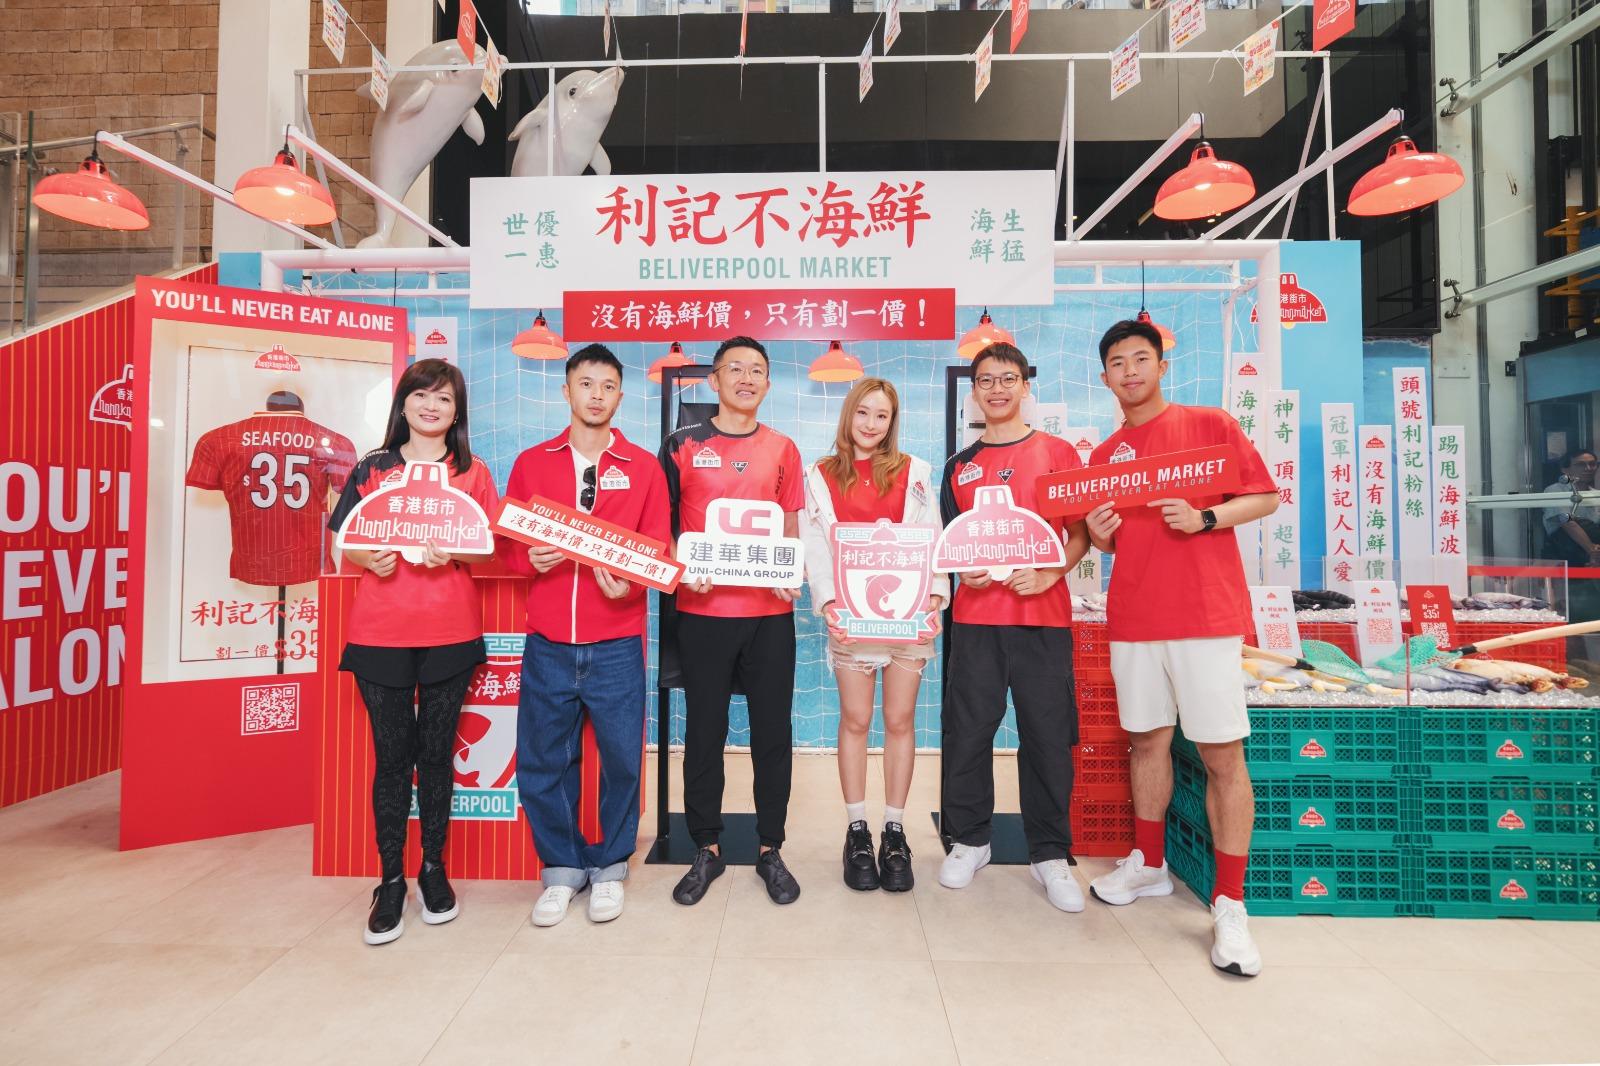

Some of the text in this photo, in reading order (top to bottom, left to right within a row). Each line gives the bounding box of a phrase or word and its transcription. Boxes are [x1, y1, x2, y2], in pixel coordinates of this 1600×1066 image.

[595, 180, 931, 248] 利記不海鮮
[639, 256, 892, 279] BELIVERPOOL MARKET
[151, 288, 394, 332] YOU'LL NEVER EAT ALONE
[241, 431, 315, 449] SEAFOOD
[1274, 398, 1295, 445] 神奇
[1400, 376, 1425, 517] 頭號利記粉絲
[1048, 458, 1226, 499] BELIVERPOOL MARKET
[1107, 486, 1141, 498] NEVER
[1149, 483, 1168, 492] EAT
[1175, 477, 1213, 488] ALONE
[1329, 415, 1353, 582] 冠軍利記人人愛
[1438, 434, 1461, 555] 踢甩海鮮波
[388, 496, 456, 516] 香港街市
[1365, 460, 1387, 580] 沒有海鮮價
[531, 502, 659, 557] YOU'LL NEVER EAT ALONE
[966, 518, 1025, 537] 香港街市
[1273, 524, 1295, 570] 超卓
[688, 566, 794, 579] UNI-CHINA GROUP
[690, 541, 796, 566] 建華集團
[841, 549, 926, 568] 利記不海鮮
[851, 622, 913, 635] BELIVERPOOL
